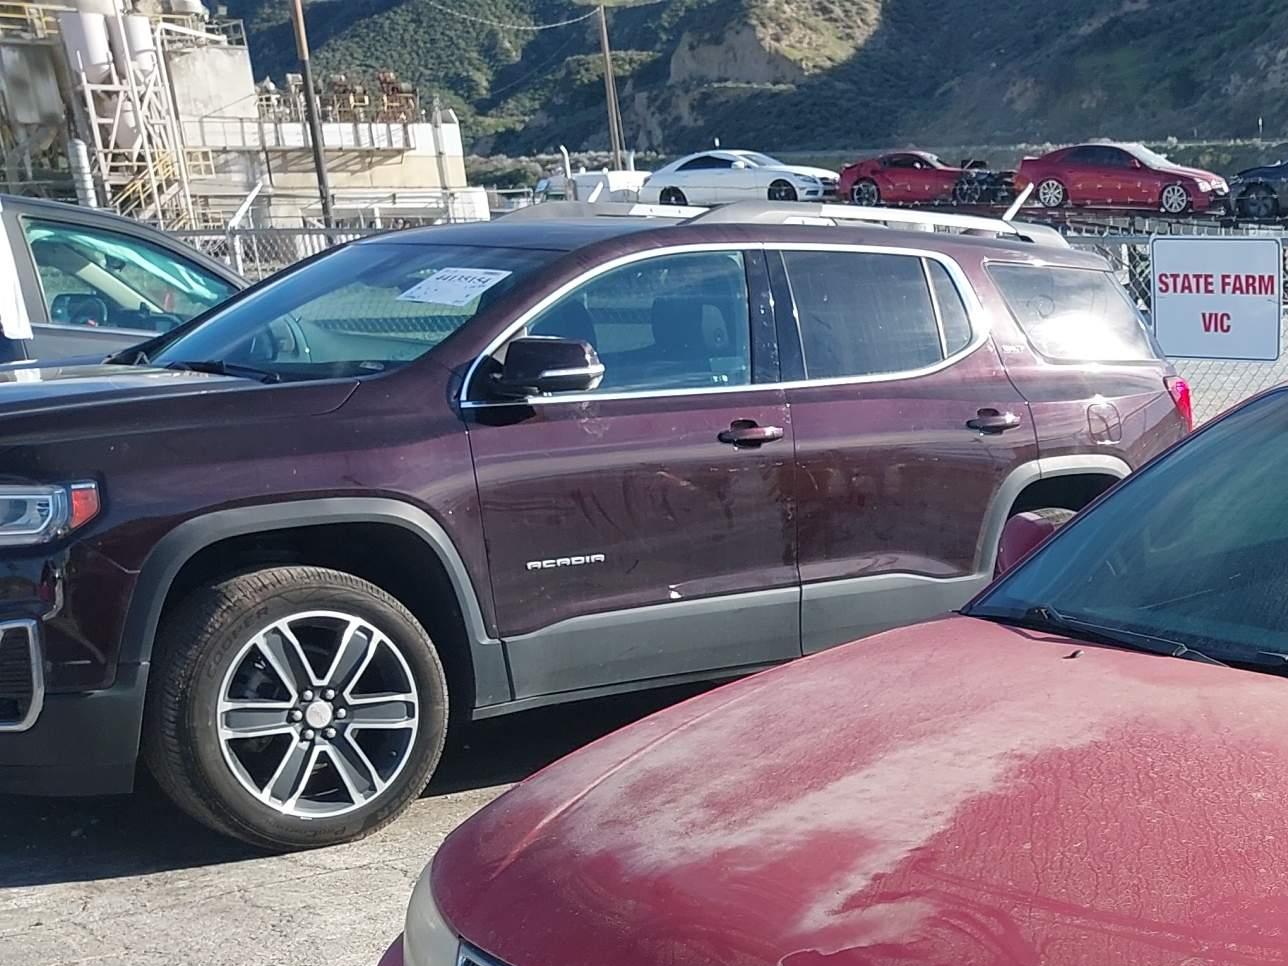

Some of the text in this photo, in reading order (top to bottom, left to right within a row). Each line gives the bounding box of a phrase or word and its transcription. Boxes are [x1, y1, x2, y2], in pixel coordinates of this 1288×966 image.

[1158, 273, 1275, 296] STATE FARM
[1202, 312, 1231, 333] VIC
[526, 553, 605, 570] ACADIA
